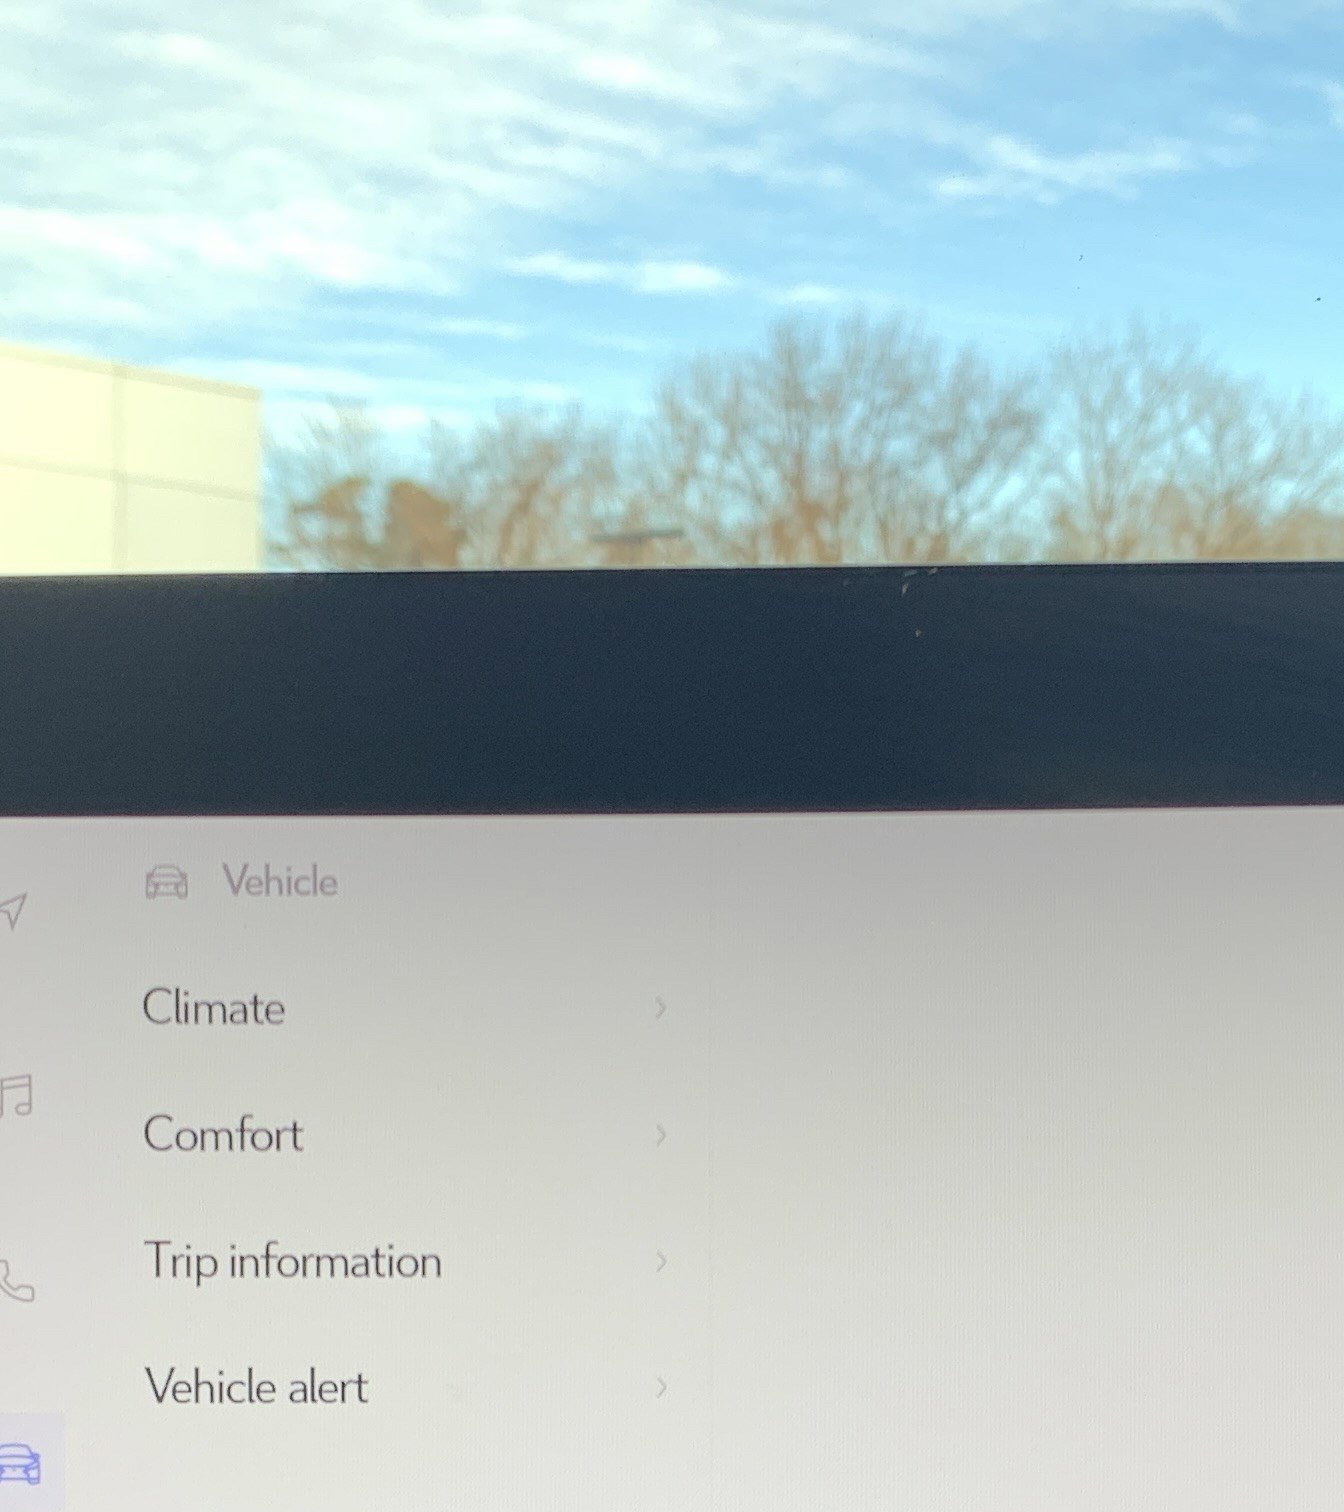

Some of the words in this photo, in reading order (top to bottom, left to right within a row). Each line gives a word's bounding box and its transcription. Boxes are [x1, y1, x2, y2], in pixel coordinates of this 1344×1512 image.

[222, 862, 338, 897] Vehicle
[143, 987, 285, 1025] Climate
[144, 1114, 303, 1152] Comfort
[144, 1240, 219, 1287] Trip
[230, 1240, 441, 1278] information
[144, 1366, 277, 1404] Vehicle
[289, 1366, 368, 1404] alert
